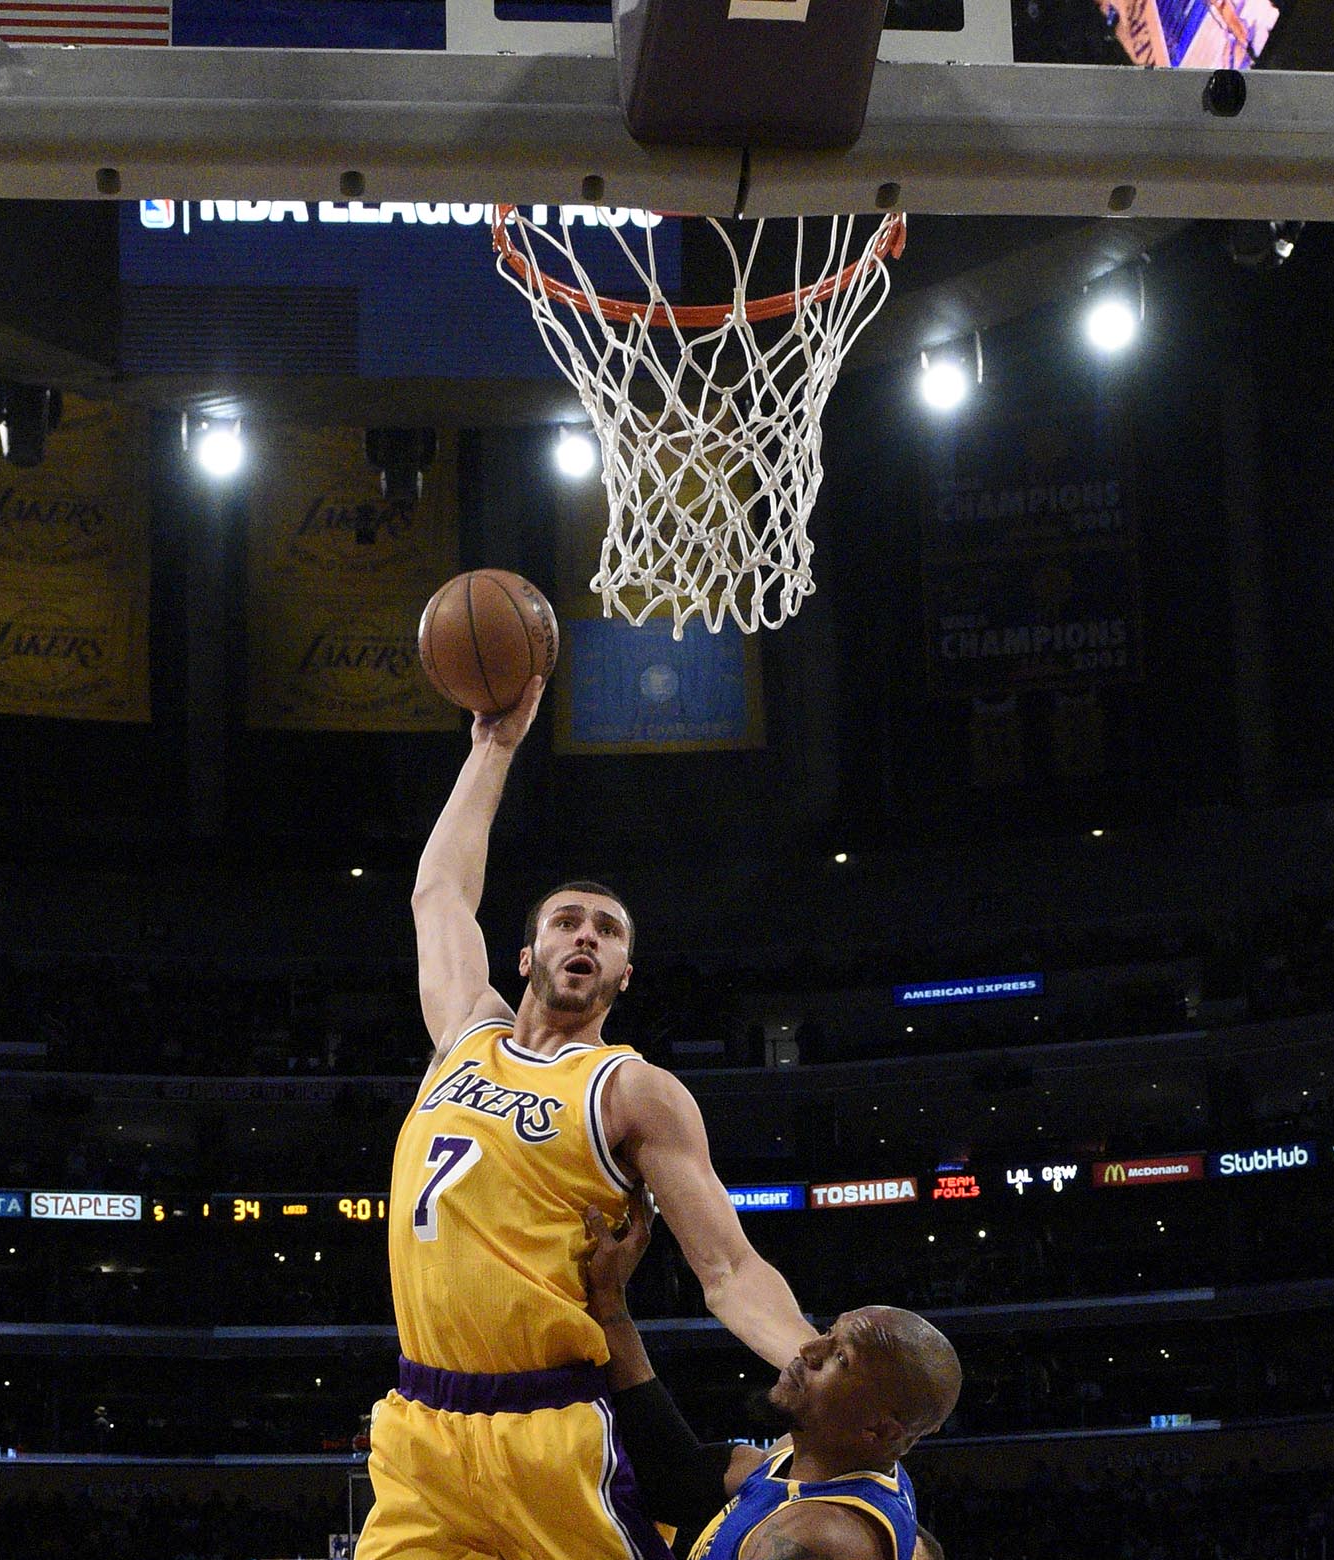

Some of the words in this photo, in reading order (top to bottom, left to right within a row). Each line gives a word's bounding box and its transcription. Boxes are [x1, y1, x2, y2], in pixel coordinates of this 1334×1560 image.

[940, 619, 1126, 660] CHAMPIONS
[903, 986, 974, 1000] AMERICAN
[976, 980, 1037, 994] EXPRESS
[417, 1060, 564, 1144] LAKERS
[1127, 1163, 1190, 1178] McDonald's
[1219, 1146, 1309, 1176] StubHub
[937, 1176, 976, 1188] TEAM
[1006, 1168, 1034, 1185] LAL
[413, 1135, 483, 1242] 7
[745, 1191, 790, 1206] LIGHT
[812, 1180, 915, 1206] TOSHIBA
[933, 1185, 981, 1200] FOULS
[33, 1196, 137, 1218] STAPLES
[233, 1199, 260, 1221] 34
[338, 1199, 385, 1220] 9:01
